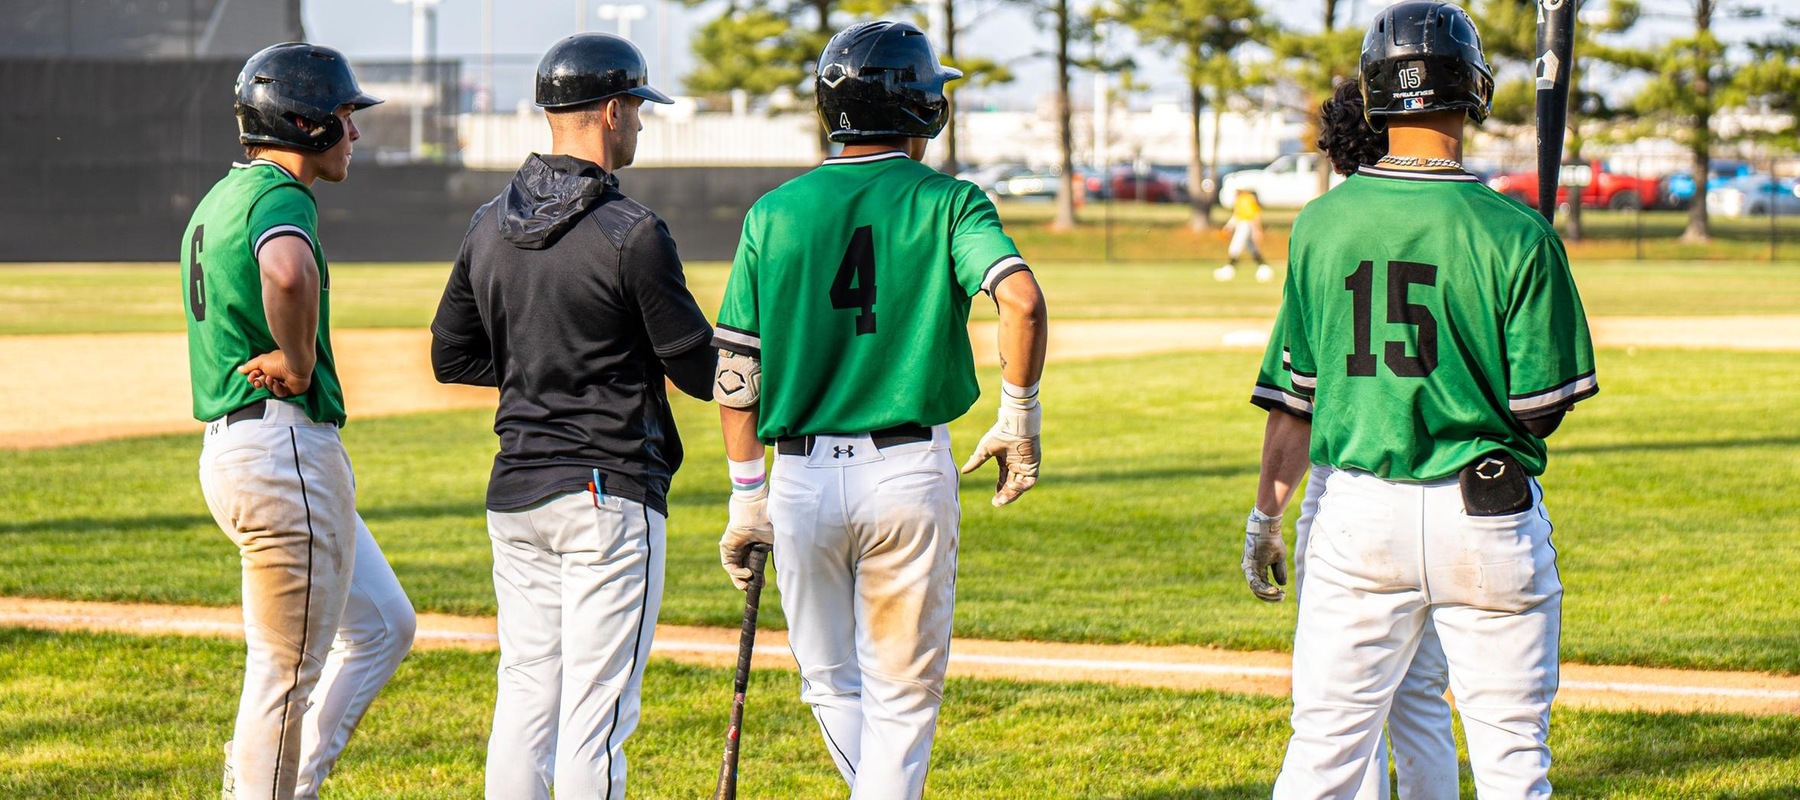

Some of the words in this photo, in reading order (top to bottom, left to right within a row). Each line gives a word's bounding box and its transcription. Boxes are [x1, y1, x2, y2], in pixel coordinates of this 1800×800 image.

[839, 111, 851, 129] 4
[1398, 67, 1420, 89] 15
[189, 224, 206, 322] 6
[829, 224, 877, 336] 4
[1344, 260, 1439, 378] 15
